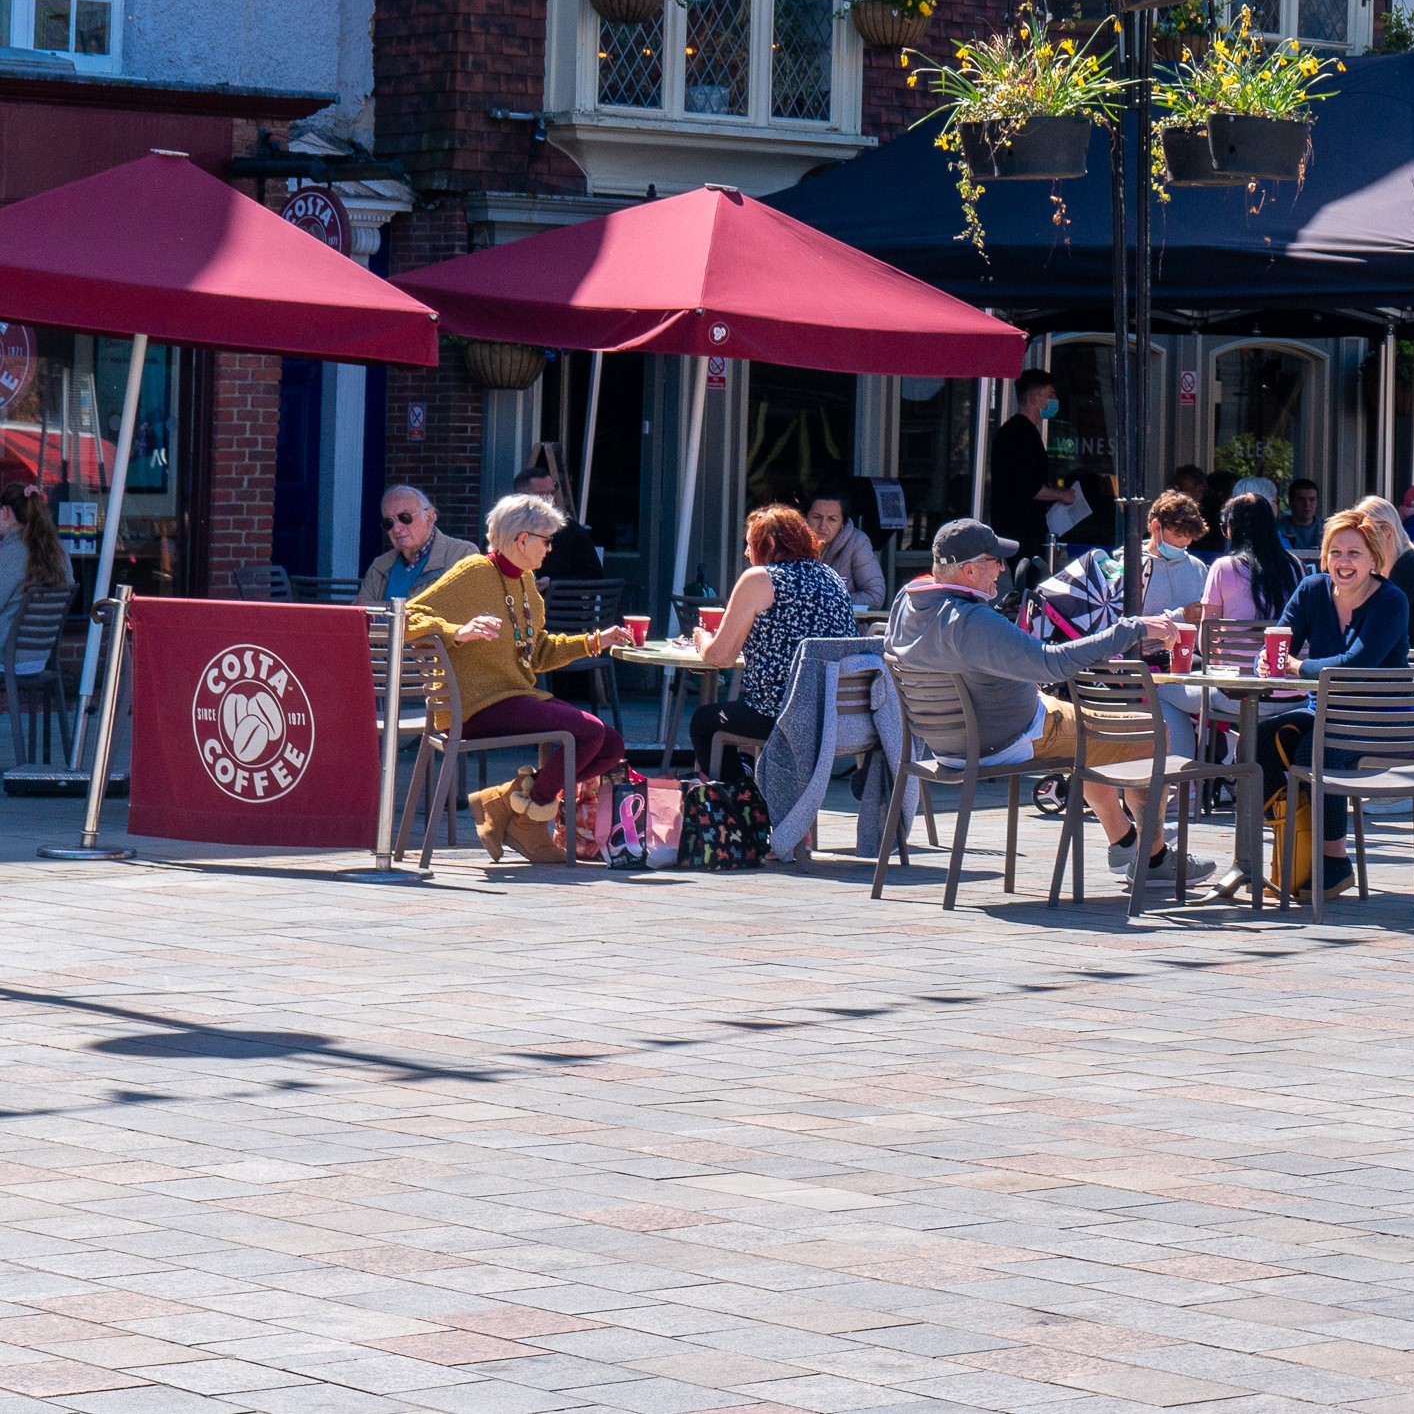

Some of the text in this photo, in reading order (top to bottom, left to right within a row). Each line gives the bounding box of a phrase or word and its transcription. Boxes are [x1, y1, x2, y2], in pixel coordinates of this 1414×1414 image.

[285, 195, 332, 227] COSTA
[1056, 436, 1116, 456] WINES
[1234, 441, 1273, 458] ALES
[1277, 640, 1287, 670] COSTA
[206, 650, 289, 699] COSTA
[197, 707, 217, 722] SINCE
[287, 712, 306, 726] 1971
[203, 738, 306, 797] COFFEE
